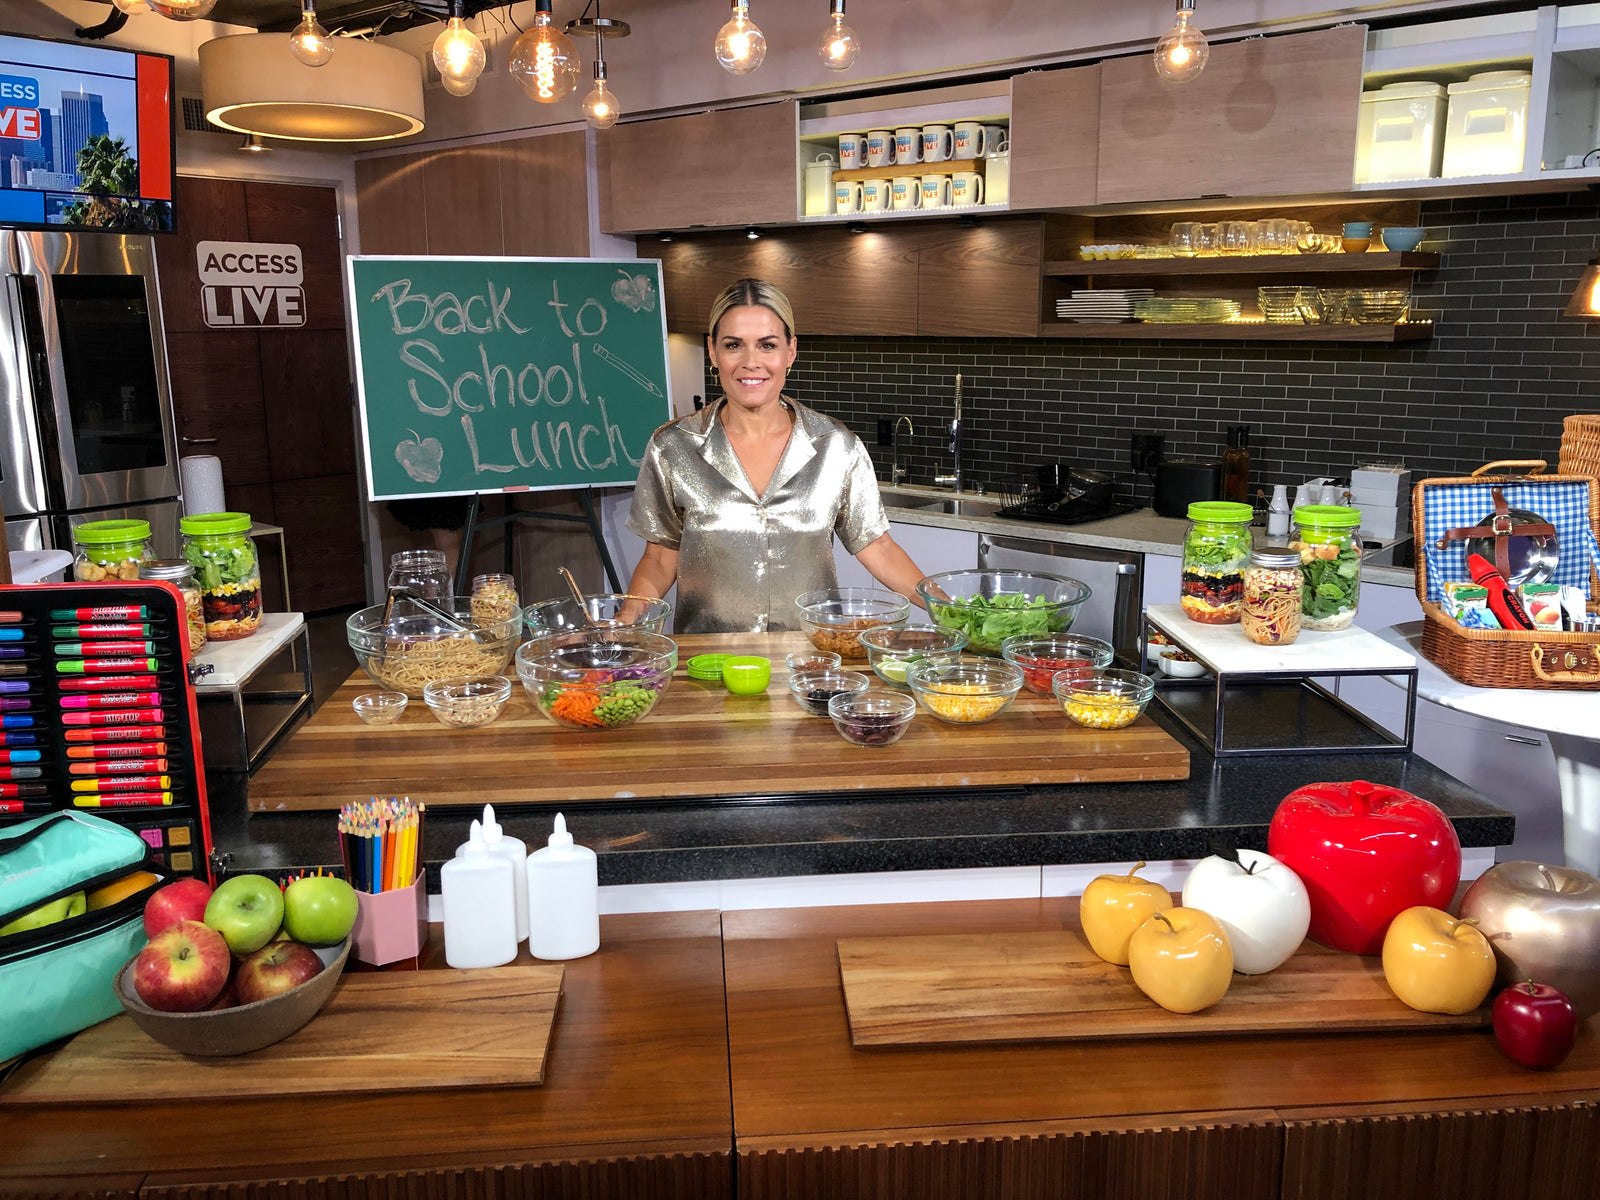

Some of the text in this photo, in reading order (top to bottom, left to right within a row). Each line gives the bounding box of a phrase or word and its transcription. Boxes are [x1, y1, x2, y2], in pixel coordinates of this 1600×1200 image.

[204, 253, 298, 274] ACCESS
[204, 287, 303, 325] LIVE
[370, 278, 608, 338] Back to
[399, 338, 589, 417] School
[461, 395, 645, 474] Lunch
[1507, 595, 1530, 624] CRAYON
